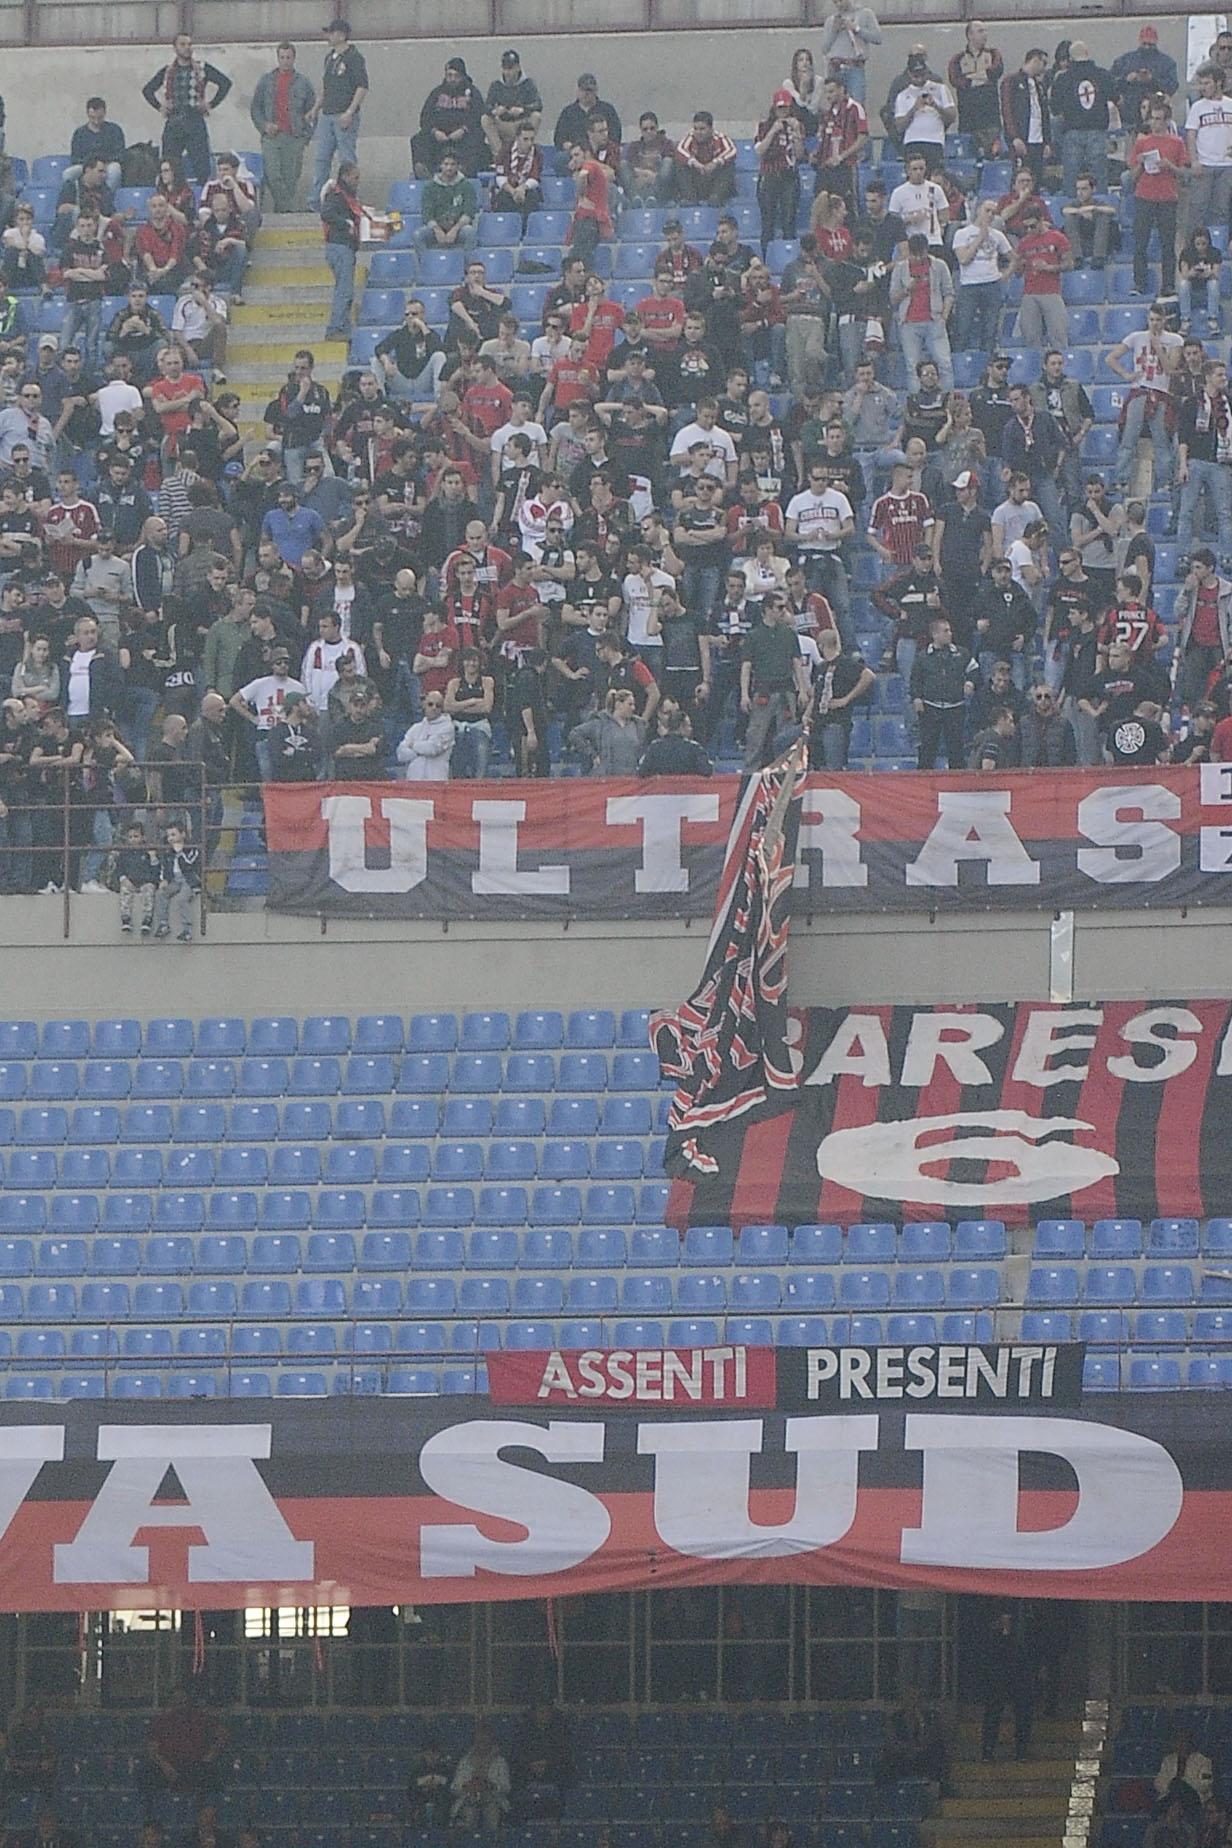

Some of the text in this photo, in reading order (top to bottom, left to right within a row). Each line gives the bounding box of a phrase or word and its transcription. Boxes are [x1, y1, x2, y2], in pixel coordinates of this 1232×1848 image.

[1113, 621, 1148, 652] 27
[815, 1109, 1121, 1206] 6
[536, 1346, 1058, 1401] ASSENTI PRESENTI
[420, 1413, 1184, 1578] SUD
